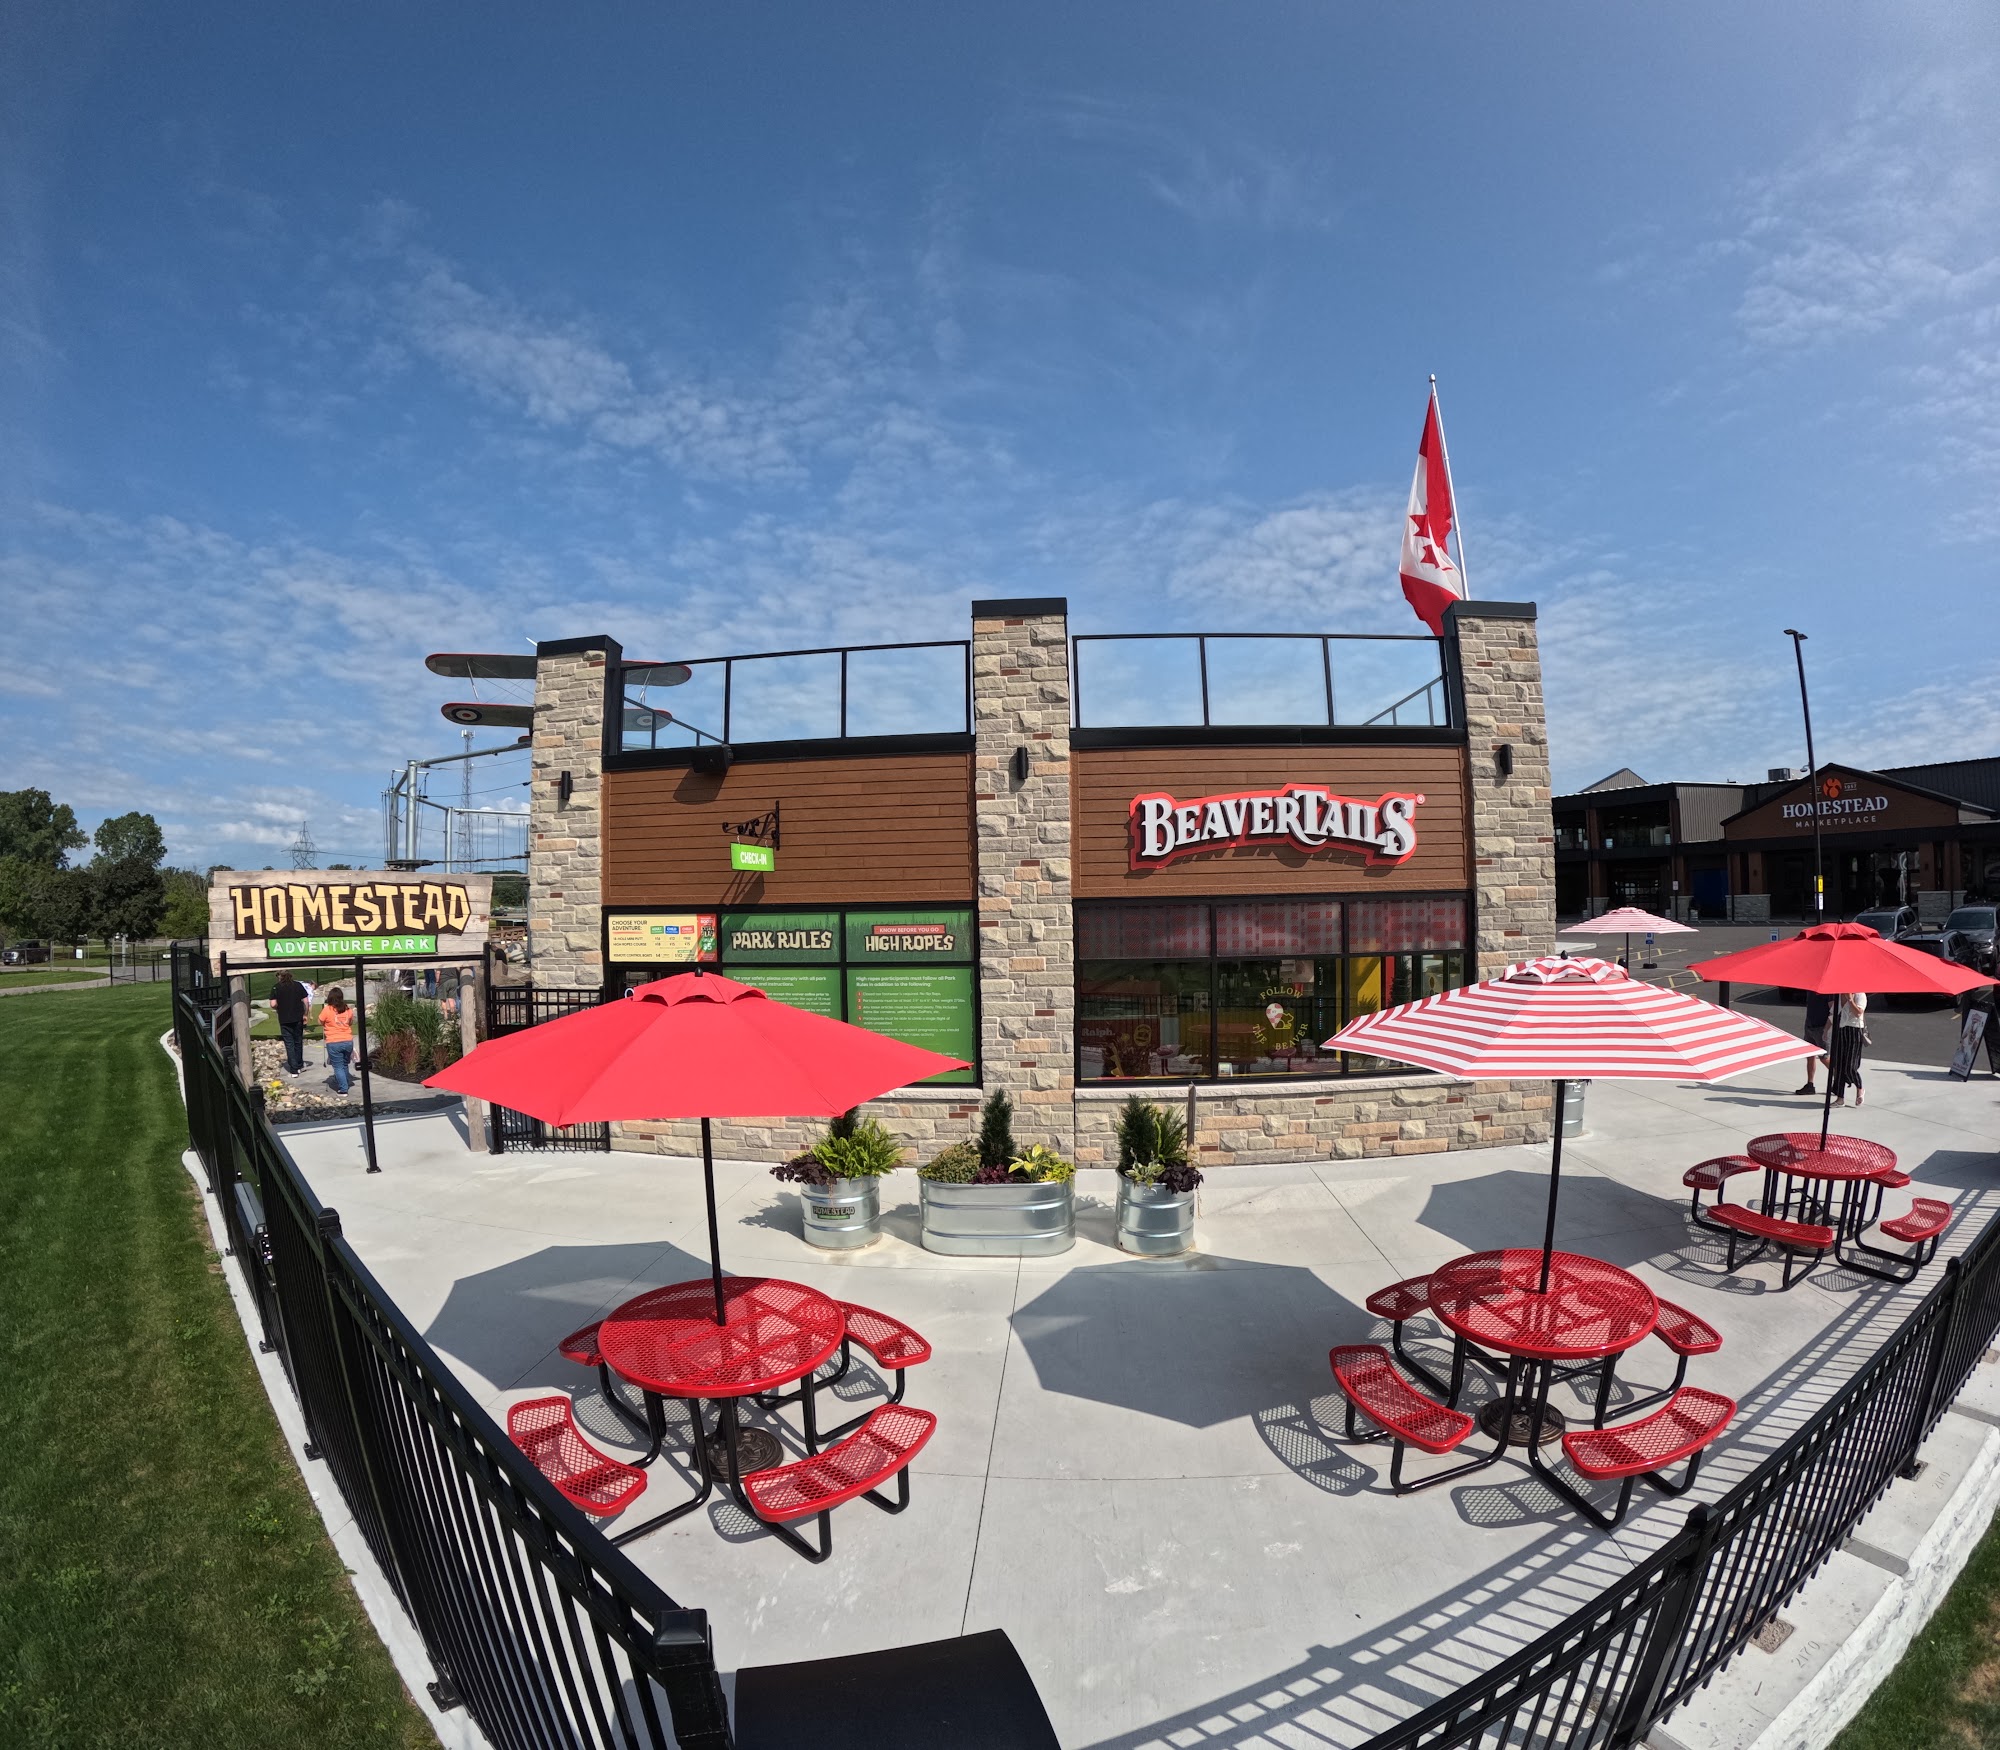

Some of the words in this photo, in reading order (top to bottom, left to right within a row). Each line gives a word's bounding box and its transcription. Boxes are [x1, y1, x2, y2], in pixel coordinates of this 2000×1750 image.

[1782, 796, 1888, 818] HOMESTEAD
[740, 851, 767, 865] CHECK-IN
[230, 884, 469, 935] HOMESTEAD
[273, 940, 373, 953] ADVENTURE
[380, 938, 430, 951] PARK
[732, 931, 775, 949] PARK
[777, 931, 833, 949] RULES
[865, 935, 900, 952] HIGH
[901, 934, 954, 951] ROPES
[1260, 986, 1303, 1000] FOLLOW
[1253, 1024, 1267, 1044] THE
[1275, 1023, 1308, 1050] BEAVER
[813, 1206, 855, 1215] HOMESTEAD
